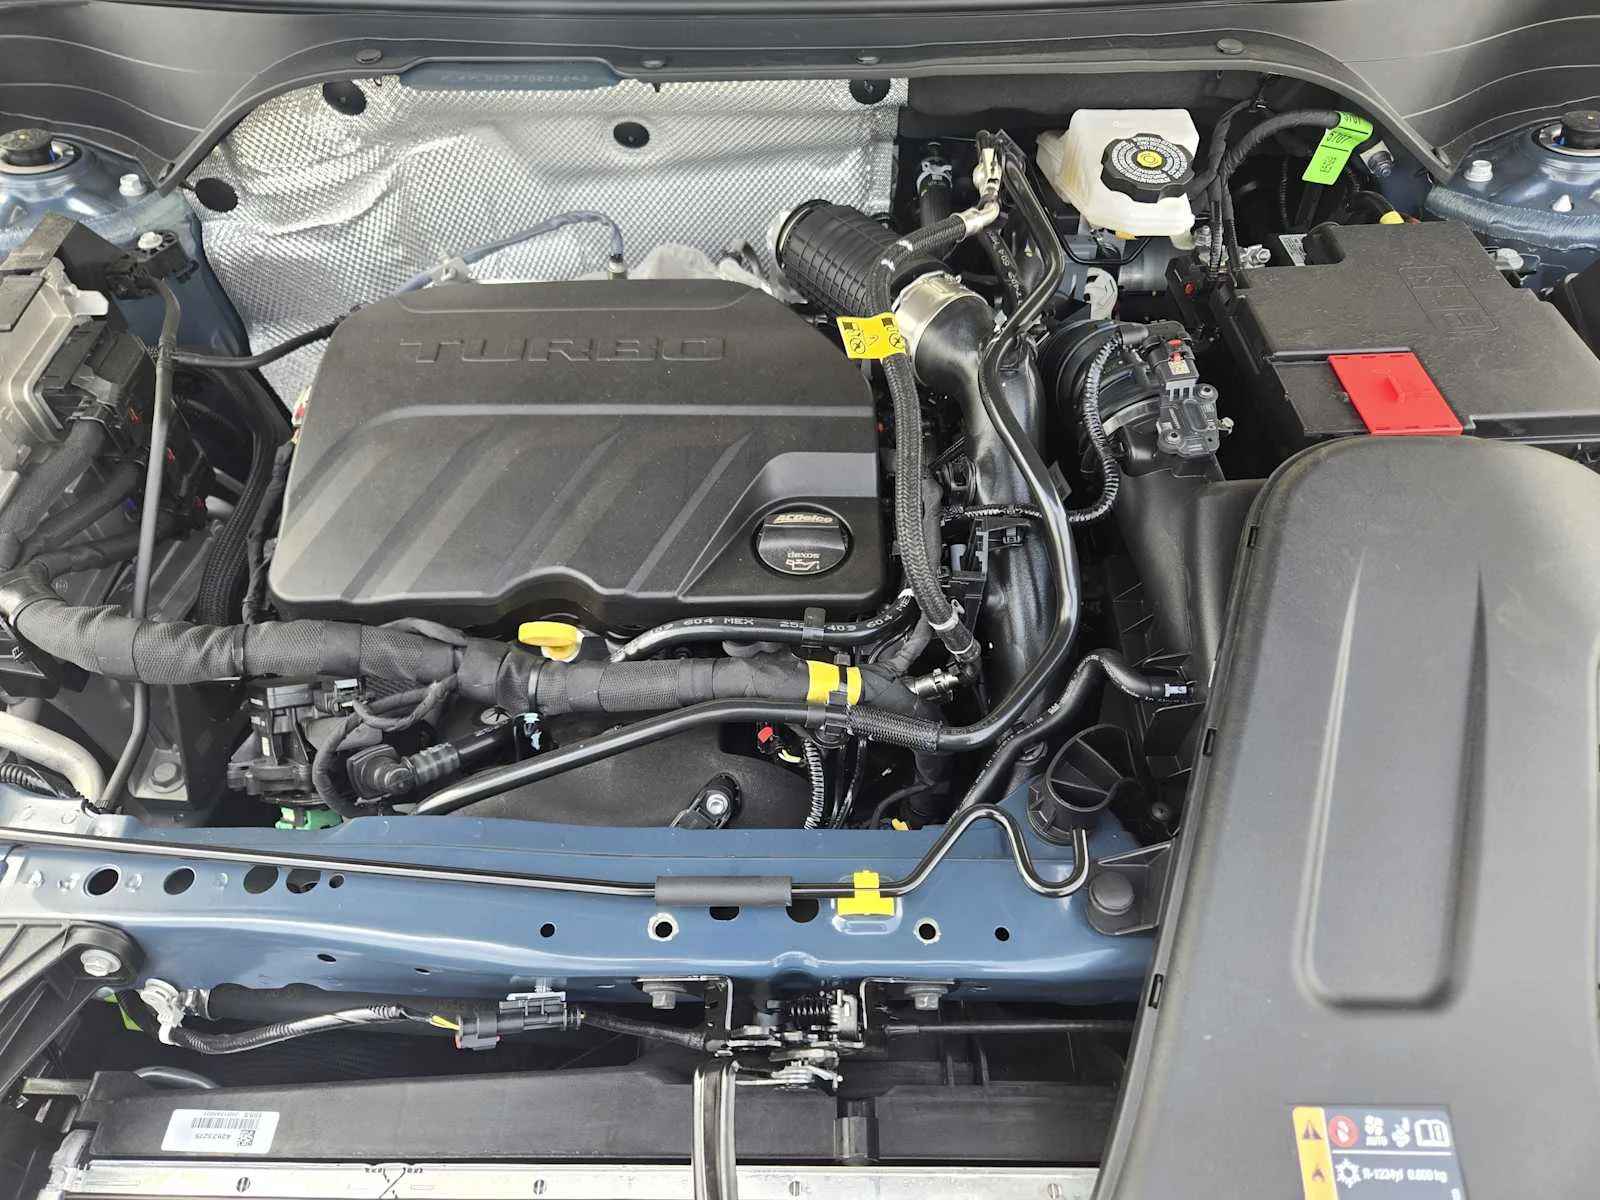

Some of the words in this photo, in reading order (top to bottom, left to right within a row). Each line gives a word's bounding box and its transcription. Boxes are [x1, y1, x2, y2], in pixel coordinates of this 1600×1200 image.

[399, 336, 727, 364] TURBO
[772, 512, 835, 525] ACDelco
[786, 551, 821, 560] dexos
[683, 617, 714, 627] 604
[723, 617, 755, 626] MEX
[866, 614, 893, 629] 604
